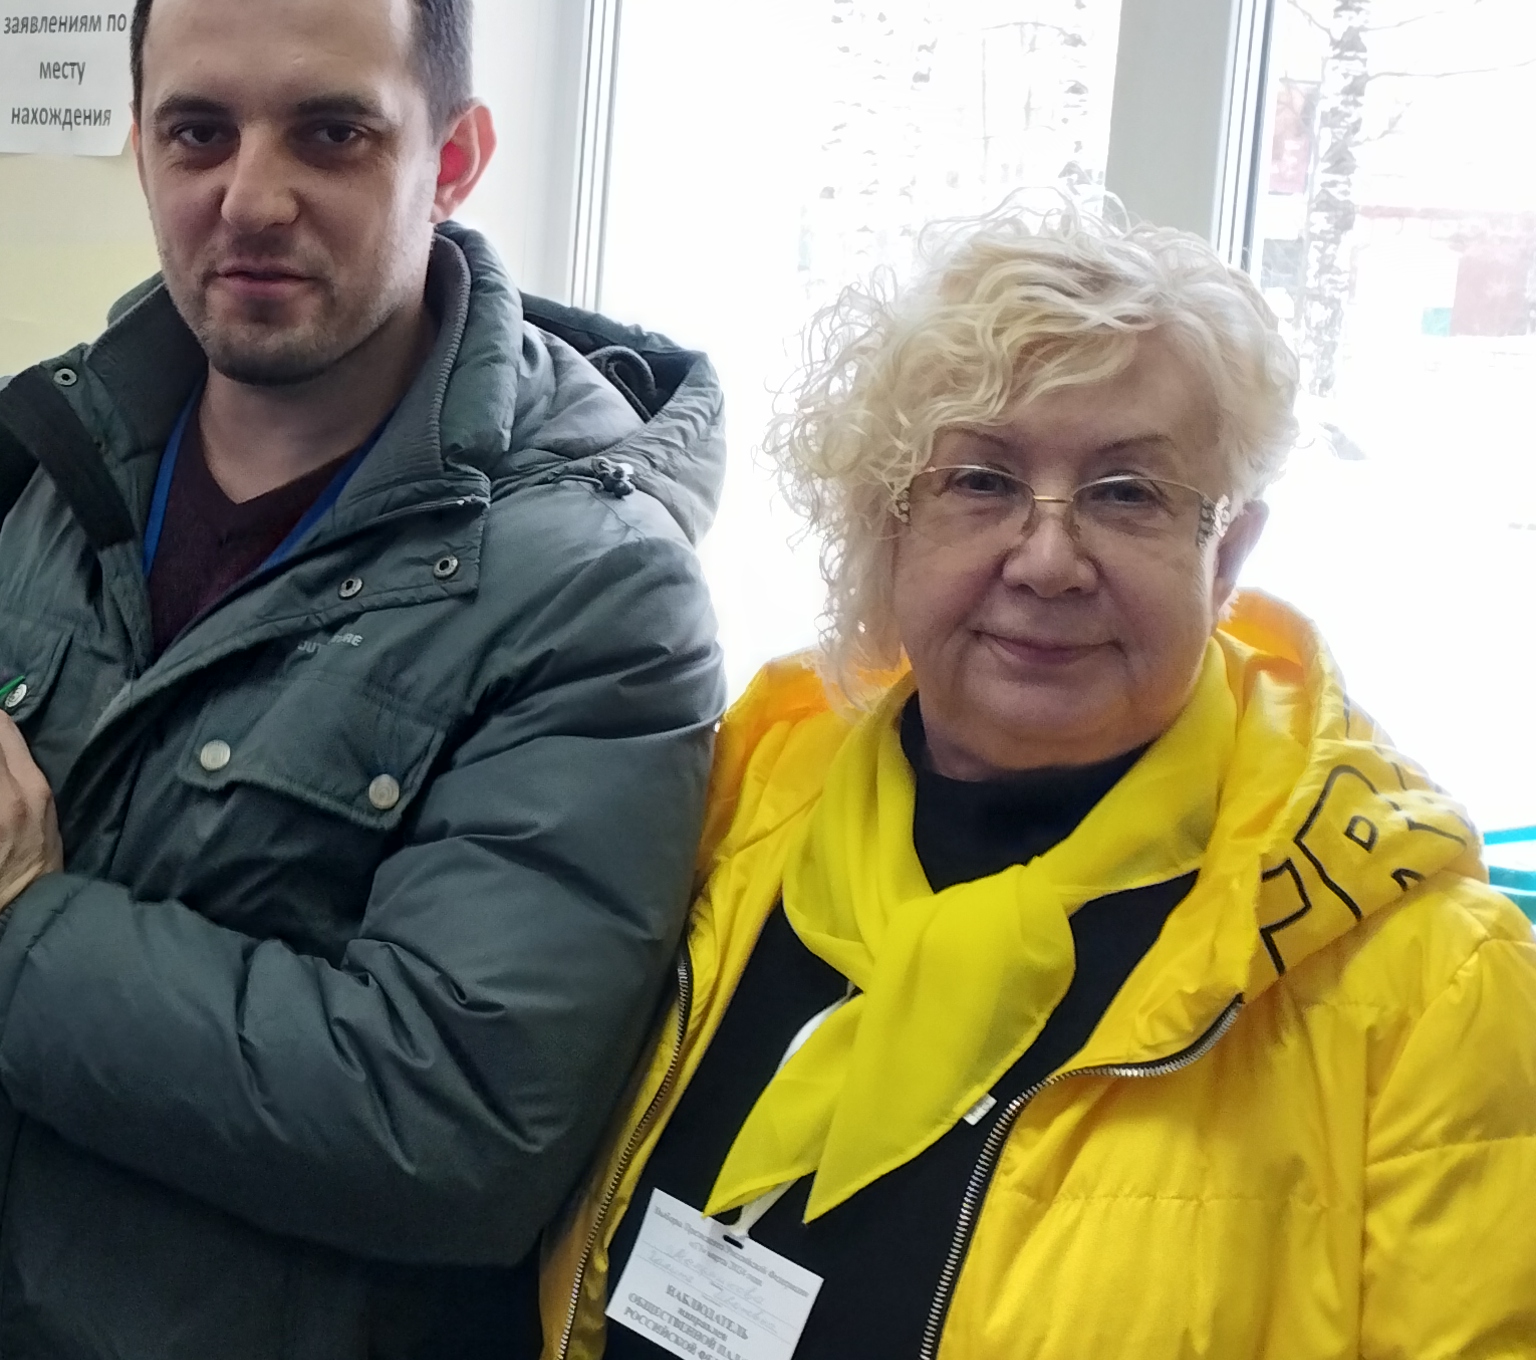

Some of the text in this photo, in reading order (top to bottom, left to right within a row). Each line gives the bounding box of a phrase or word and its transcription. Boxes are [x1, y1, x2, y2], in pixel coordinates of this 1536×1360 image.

[3, 13, 127, 34] заявлениям по
[39, 61, 86, 86] месту
[11, 106, 112, 132] нахождения
[666, 1284, 749, 1341] НАБЛЮДАТЕЛЬ
